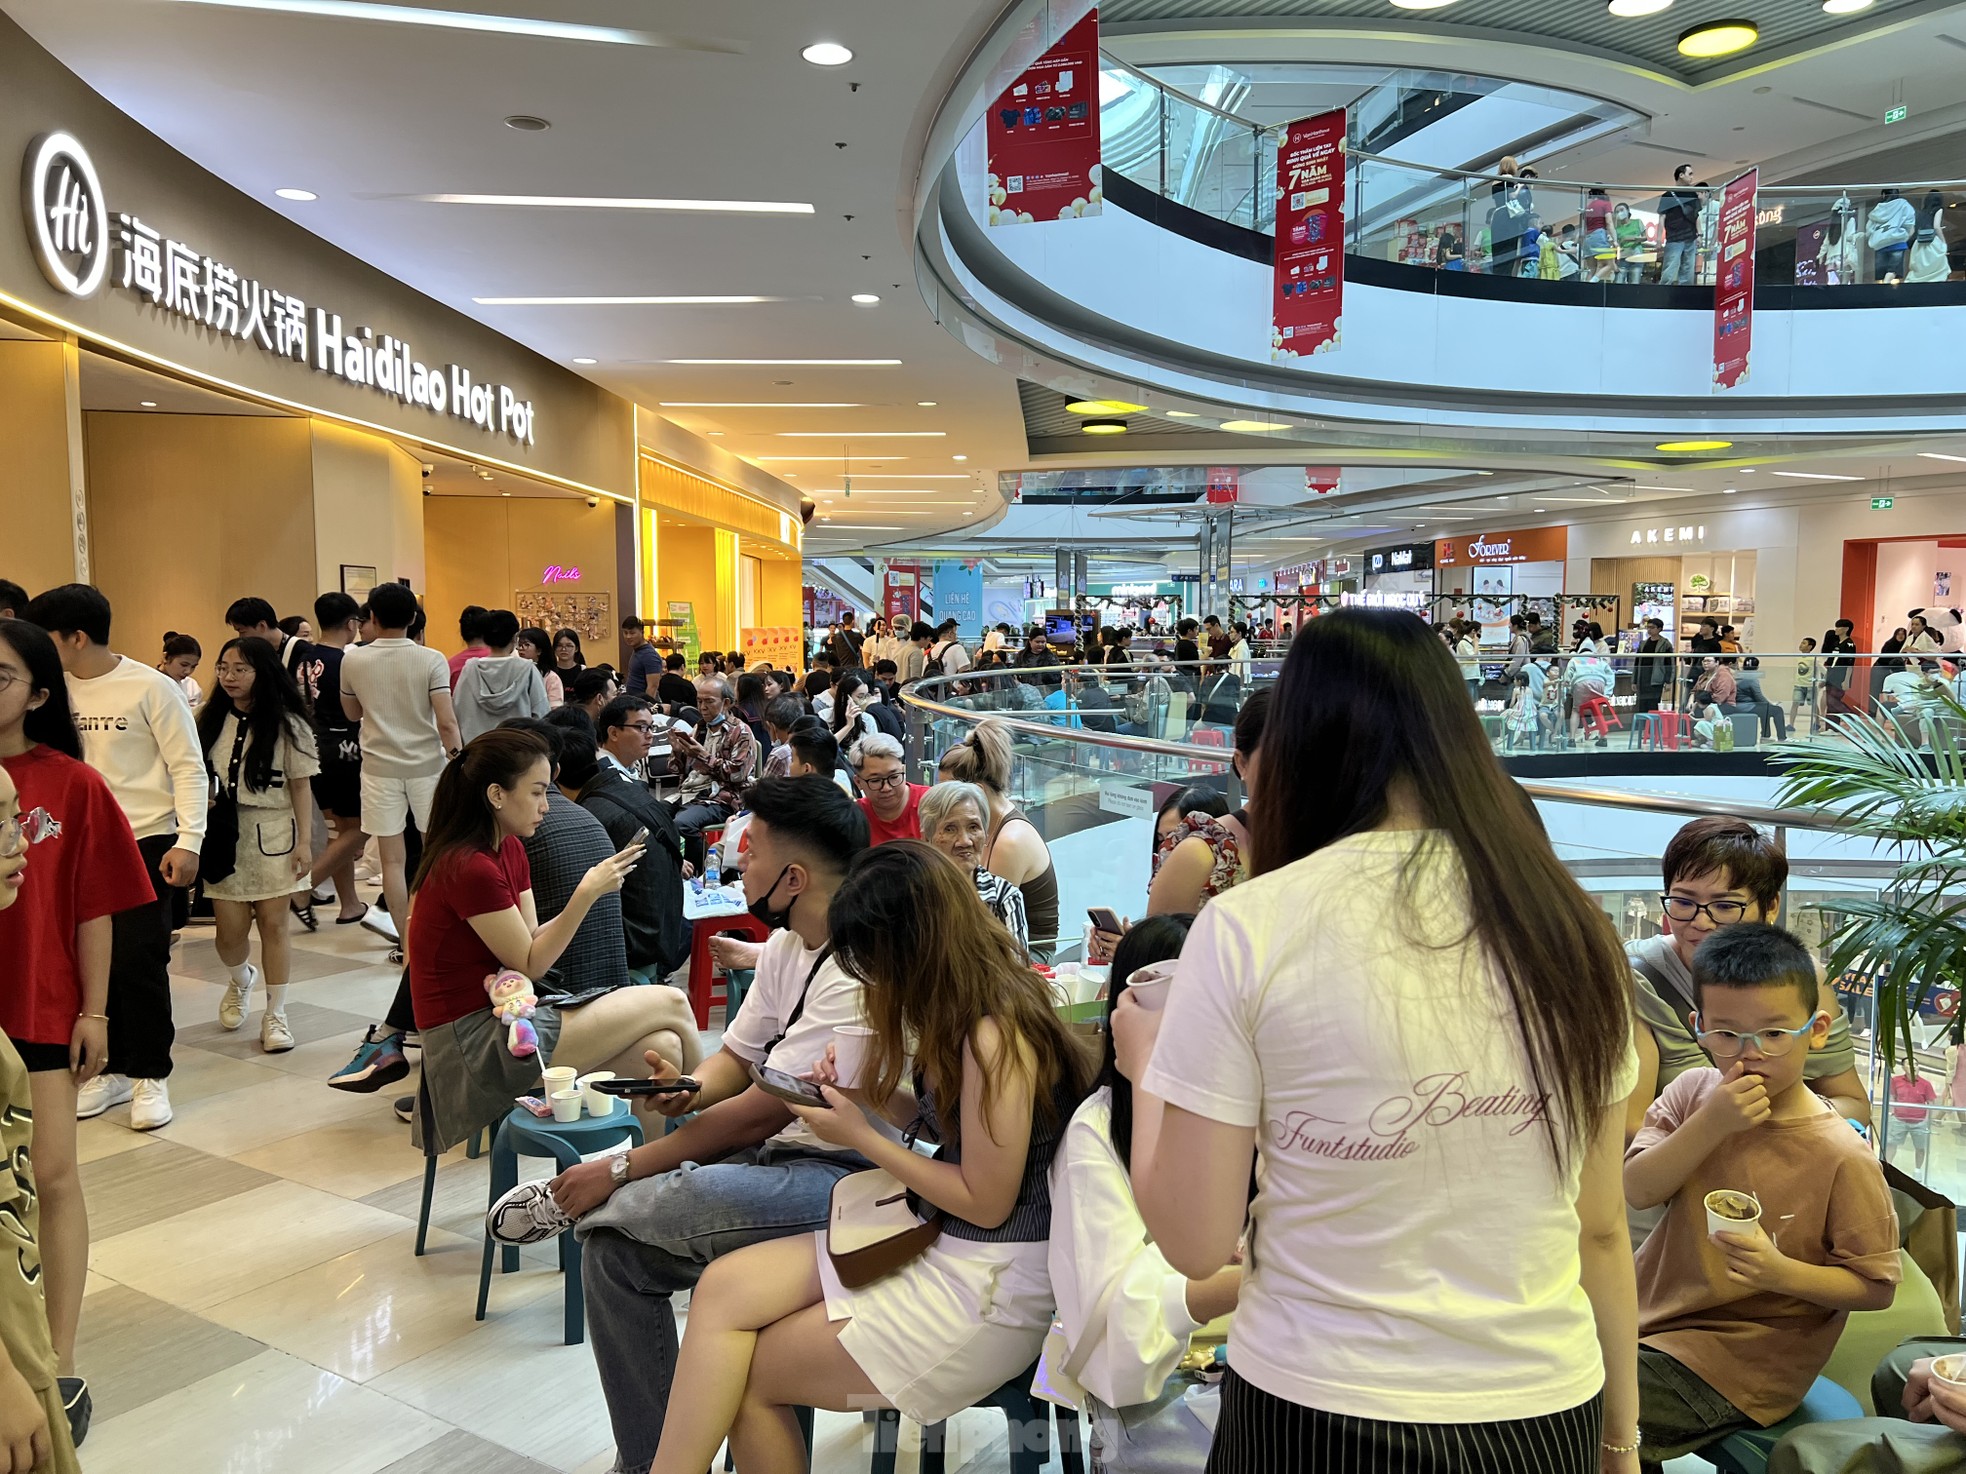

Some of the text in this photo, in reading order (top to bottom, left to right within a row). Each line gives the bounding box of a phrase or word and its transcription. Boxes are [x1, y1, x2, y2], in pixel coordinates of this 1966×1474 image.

[1288, 168, 1301, 190] 7
[1301, 164, 1327, 180] NĂM
[120, 213, 307, 362] 海底捞火锅
[317, 308, 535, 446] Haidilao Hot Pot
[1468, 535, 1510, 559] FOREVER
[1630, 526, 1705, 544] AKEMI
[543, 565, 581, 584] Nails
[1369, 1070, 1559, 1137] Beating
[1268, 1111, 1420, 1161] Funtstudio
